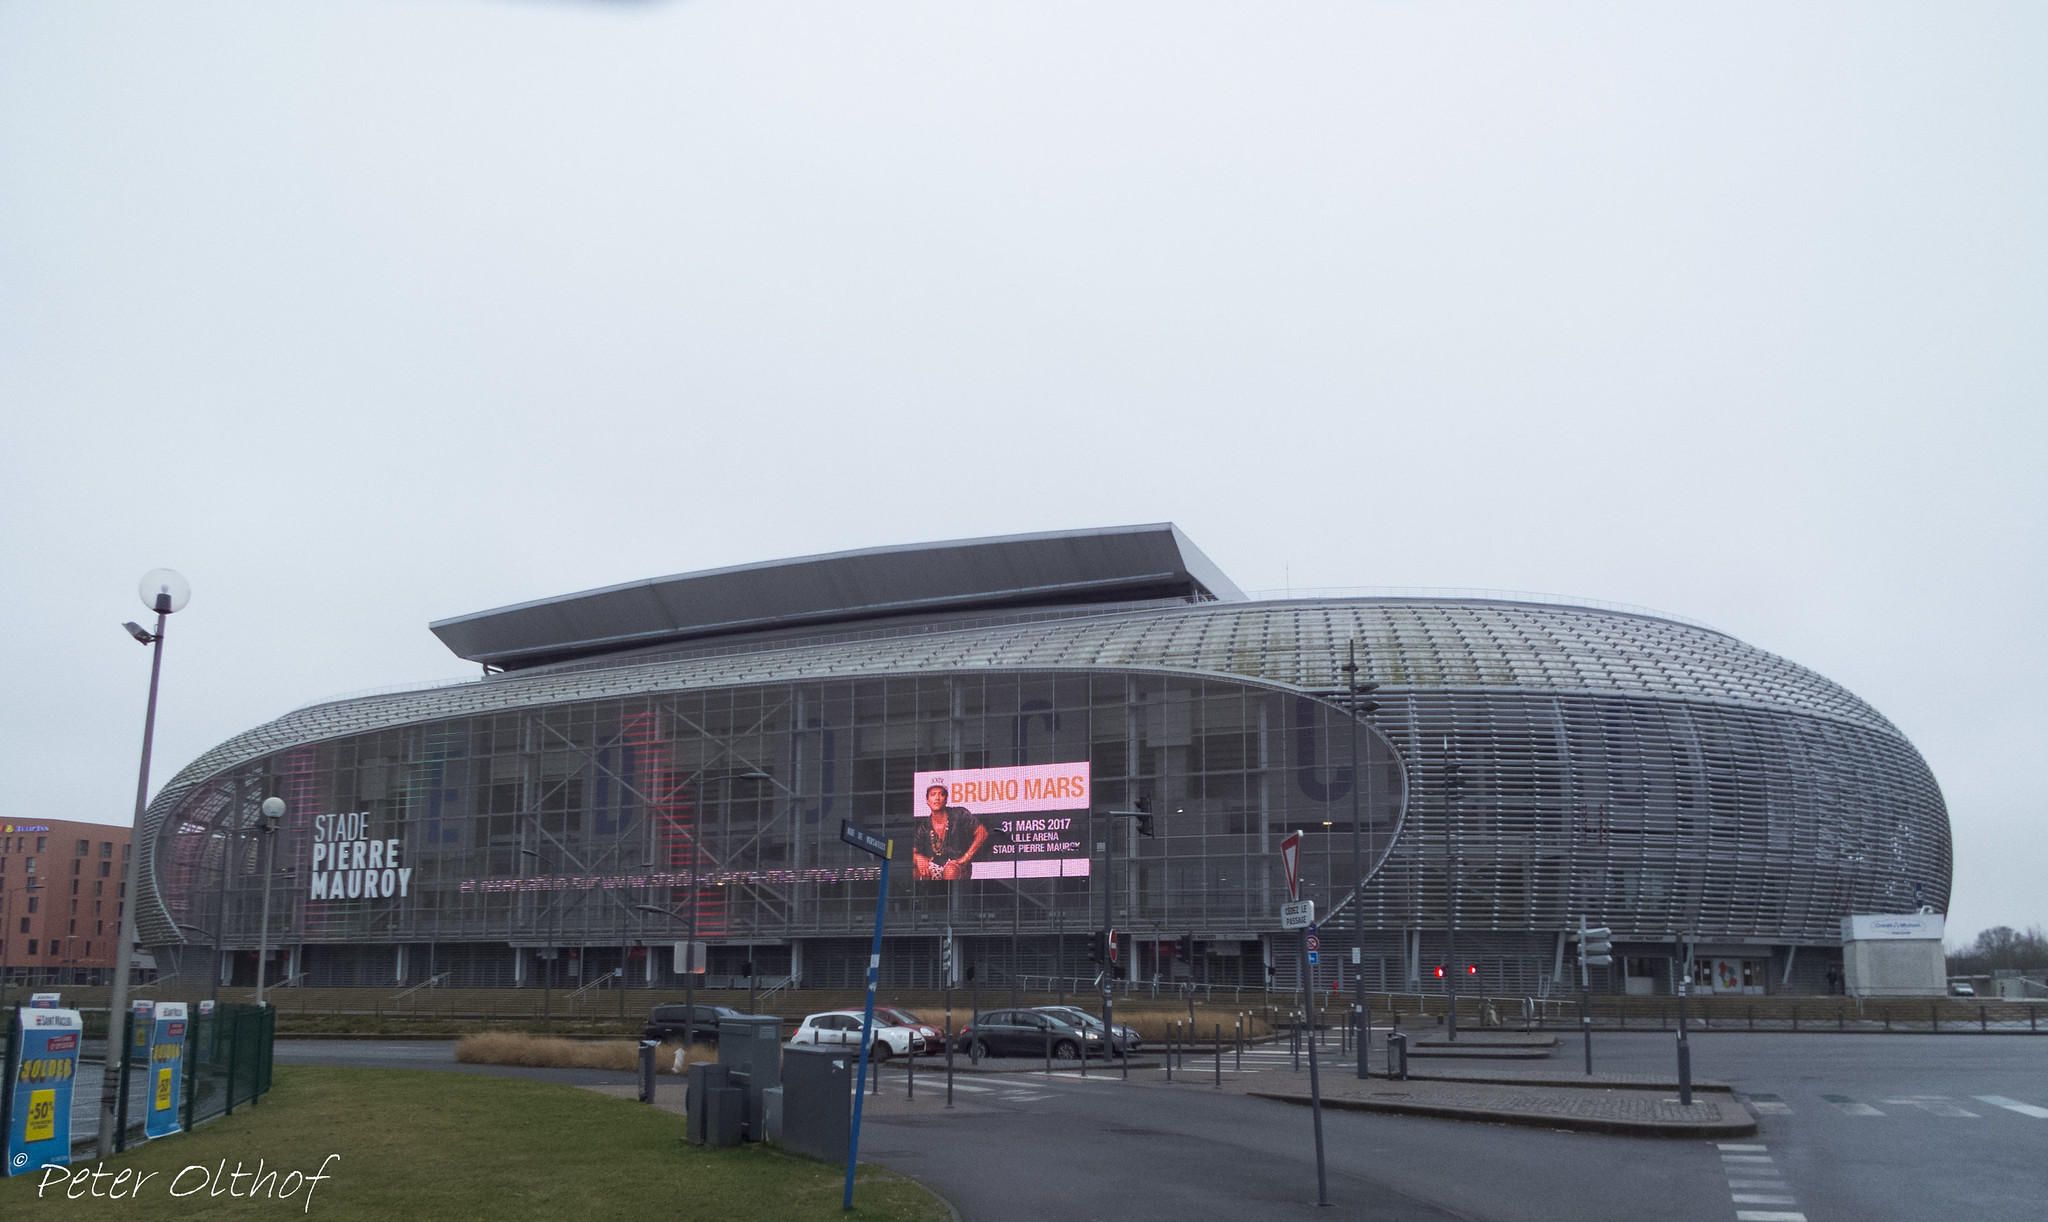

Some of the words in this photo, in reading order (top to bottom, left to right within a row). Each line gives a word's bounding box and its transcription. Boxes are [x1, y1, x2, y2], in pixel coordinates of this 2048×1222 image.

[951, 779, 1018, 804] BRUNO
[1025, 776, 1084, 800] MARS
[314, 812, 370, 842] STADE
[1001, 821, 1013, 832] 31
[1016, 820, 1045, 831] MARS
[1048, 818, 1071, 830] 2017
[1032, 832, 1059, 842] ARENA
[313, 839, 400, 871] PIERRE
[1018, 843, 1045, 853] PIERRE
[311, 868, 412, 900] MAUROY
[1301, 904, 1307, 913] LE
[1286, 916, 1307, 926] PASSAGE
